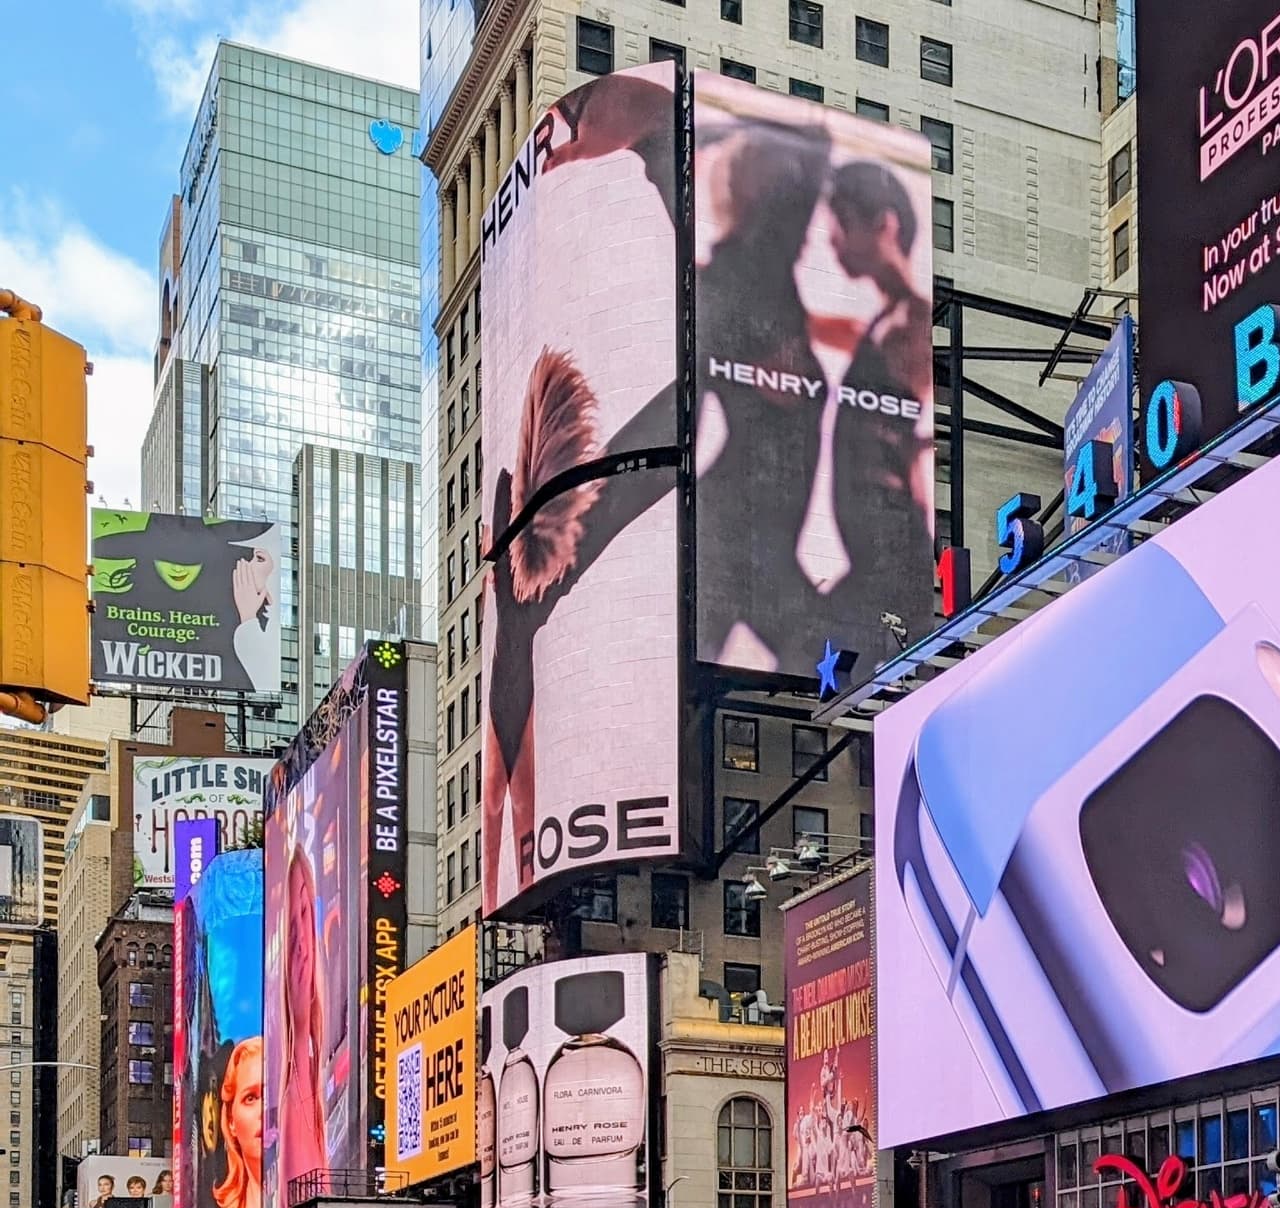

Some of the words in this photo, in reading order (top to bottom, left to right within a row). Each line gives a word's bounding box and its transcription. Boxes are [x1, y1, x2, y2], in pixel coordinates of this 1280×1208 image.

[481, 89, 588, 263] HENRY
[1203, 246, 1219, 273] In
[1221, 211, 1259, 263] your
[1203, 258, 1245, 312] Now
[1250, 234, 1271, 275] at
[708, 357, 823, 398] HENRY
[837, 385, 921, 420] ROSE
[107, 605, 165, 623] Brains.
[169, 611, 220, 627] Heart.
[127, 623, 200, 643] Courage.
[376, 688, 398, 800] PIXELSTAR
[152, 764, 228, 802] LITTLE
[234, 766, 264, 795] SH
[209, 794, 225, 803] OF
[376, 805, 398, 822] A
[376, 823, 397, 851] BE
[520, 797, 673, 887] ROSE
[376, 917, 397, 961] APP
[394, 998, 421, 1048] YOUR
[423, 969, 464, 1032] PICTURE
[793, 1015, 800, 1061] A
[800, 1001, 845, 1060] BEAUTIFUL
[846, 988, 872, 1043] NOISE
[426, 1038, 463, 1111] HERE
[700, 1057, 734, 1073] THE
[554, 1090, 572, 1099] FLORA
[578, 1086, 622, 1096] CARNIVORA
[552, 1124, 588, 1133] HENRY
[572, 1137, 582, 1145] DE
[592, 1135, 623, 1144] PARFUM
